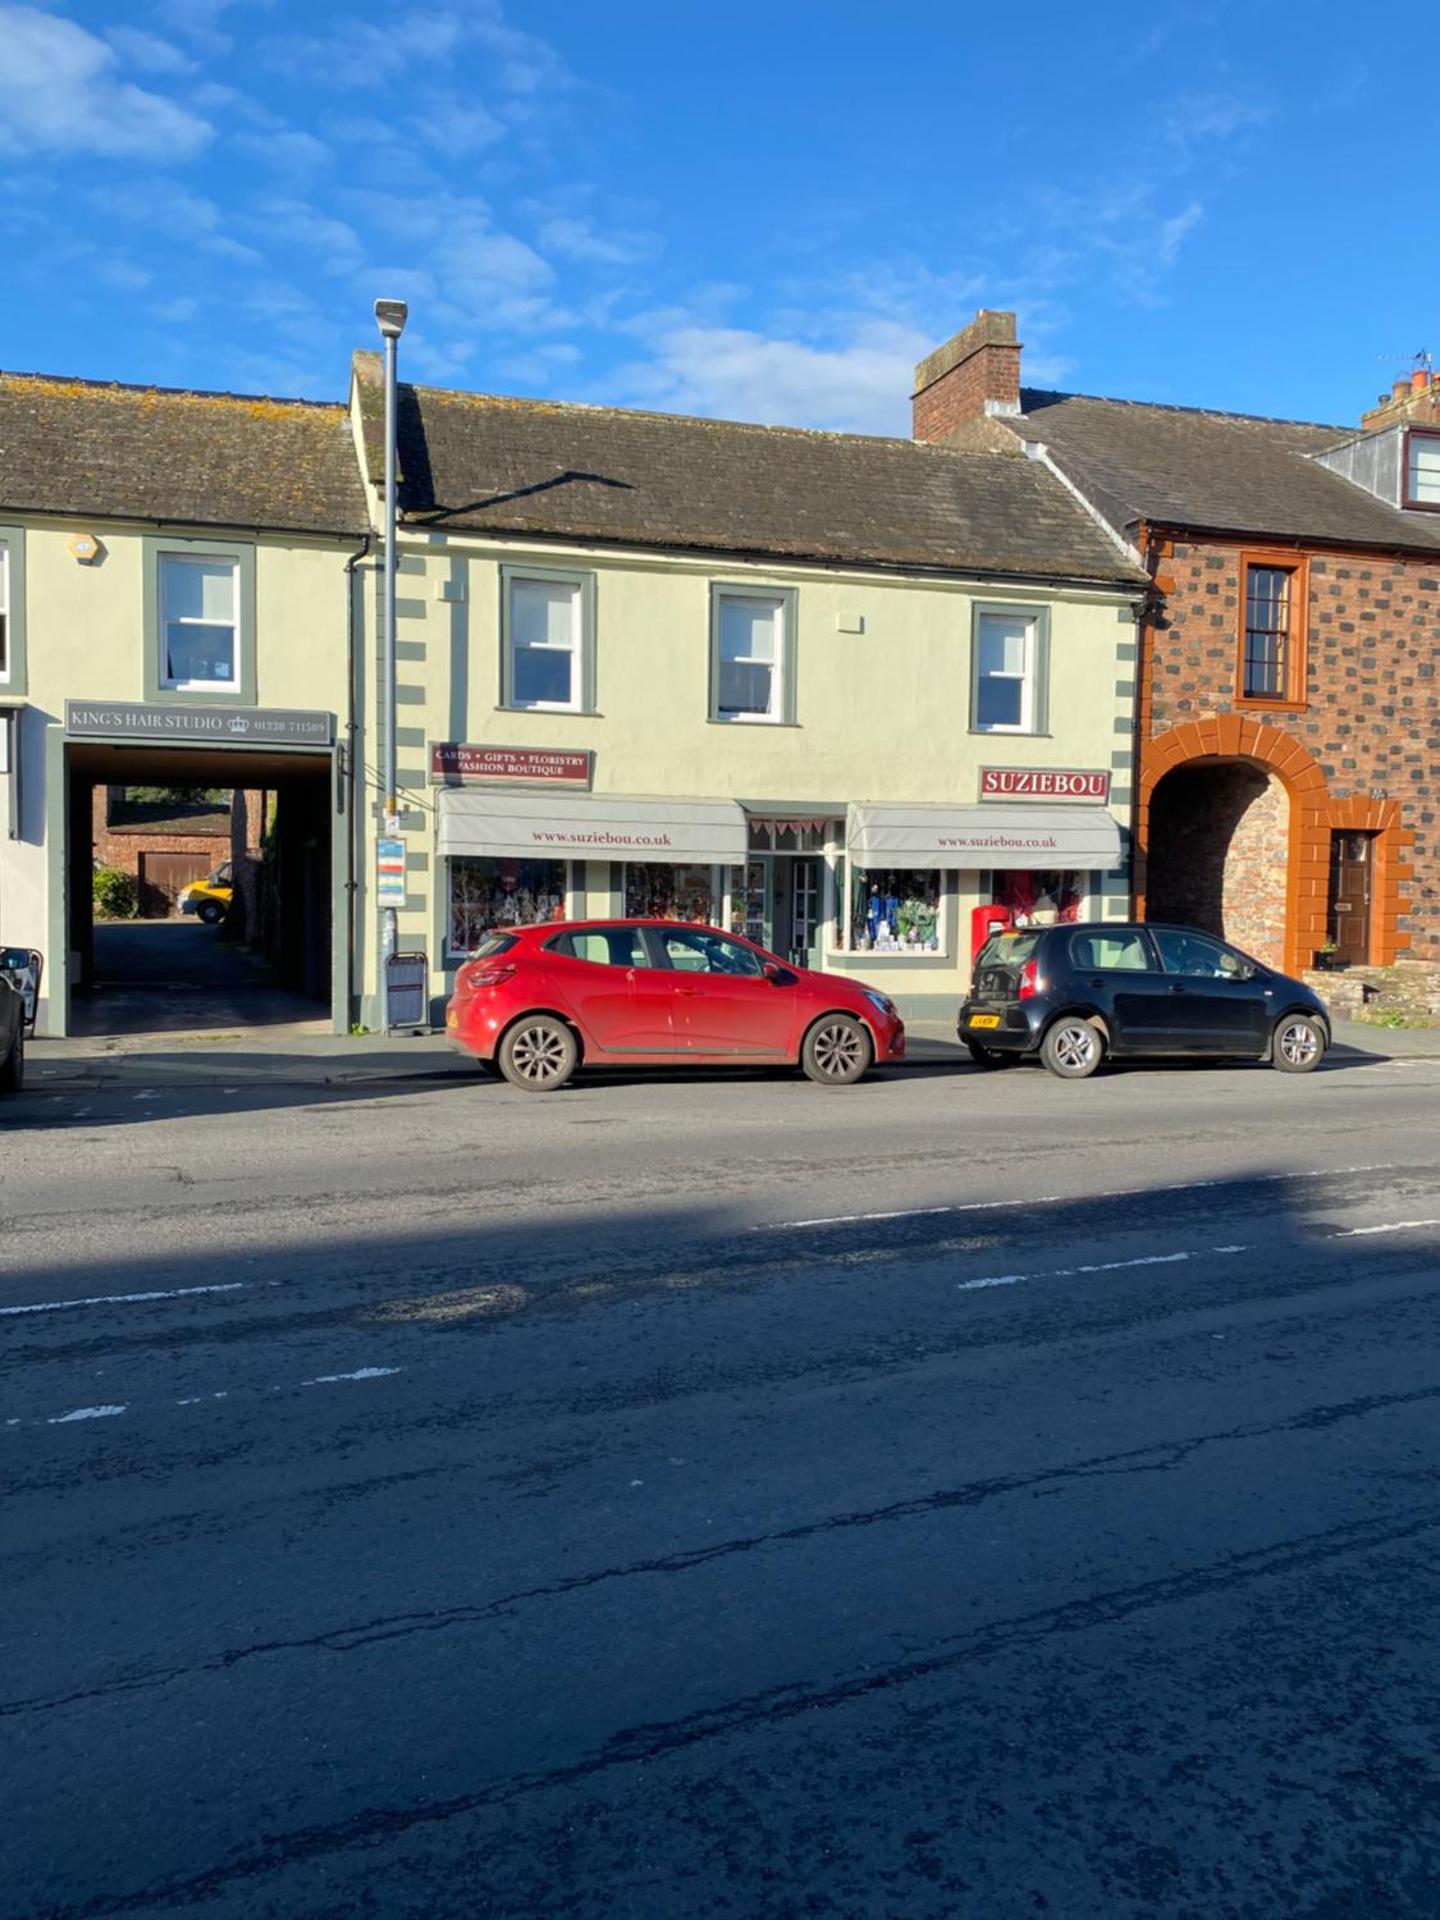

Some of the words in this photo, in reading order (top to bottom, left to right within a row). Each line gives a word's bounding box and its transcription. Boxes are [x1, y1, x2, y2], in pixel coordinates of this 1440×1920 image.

[72, 711, 122, 726] KING'S
[126, 713, 161, 727] HAIR
[164, 715, 222, 730] STUDIO
[436, 750, 471, 760] CARDS
[484, 752, 516, 763] GIFTS
[529, 755, 585, 766] FLORISTRY
[459, 762, 505, 772] FASHION
[507, 765, 564, 775] BOUTIQUE
[986, 772, 1103, 794] SUZIEBOU
[532, 831, 672, 846] www.suziebou.co.uk
[938, 835, 1057, 848] www.suziebou.co.uk
